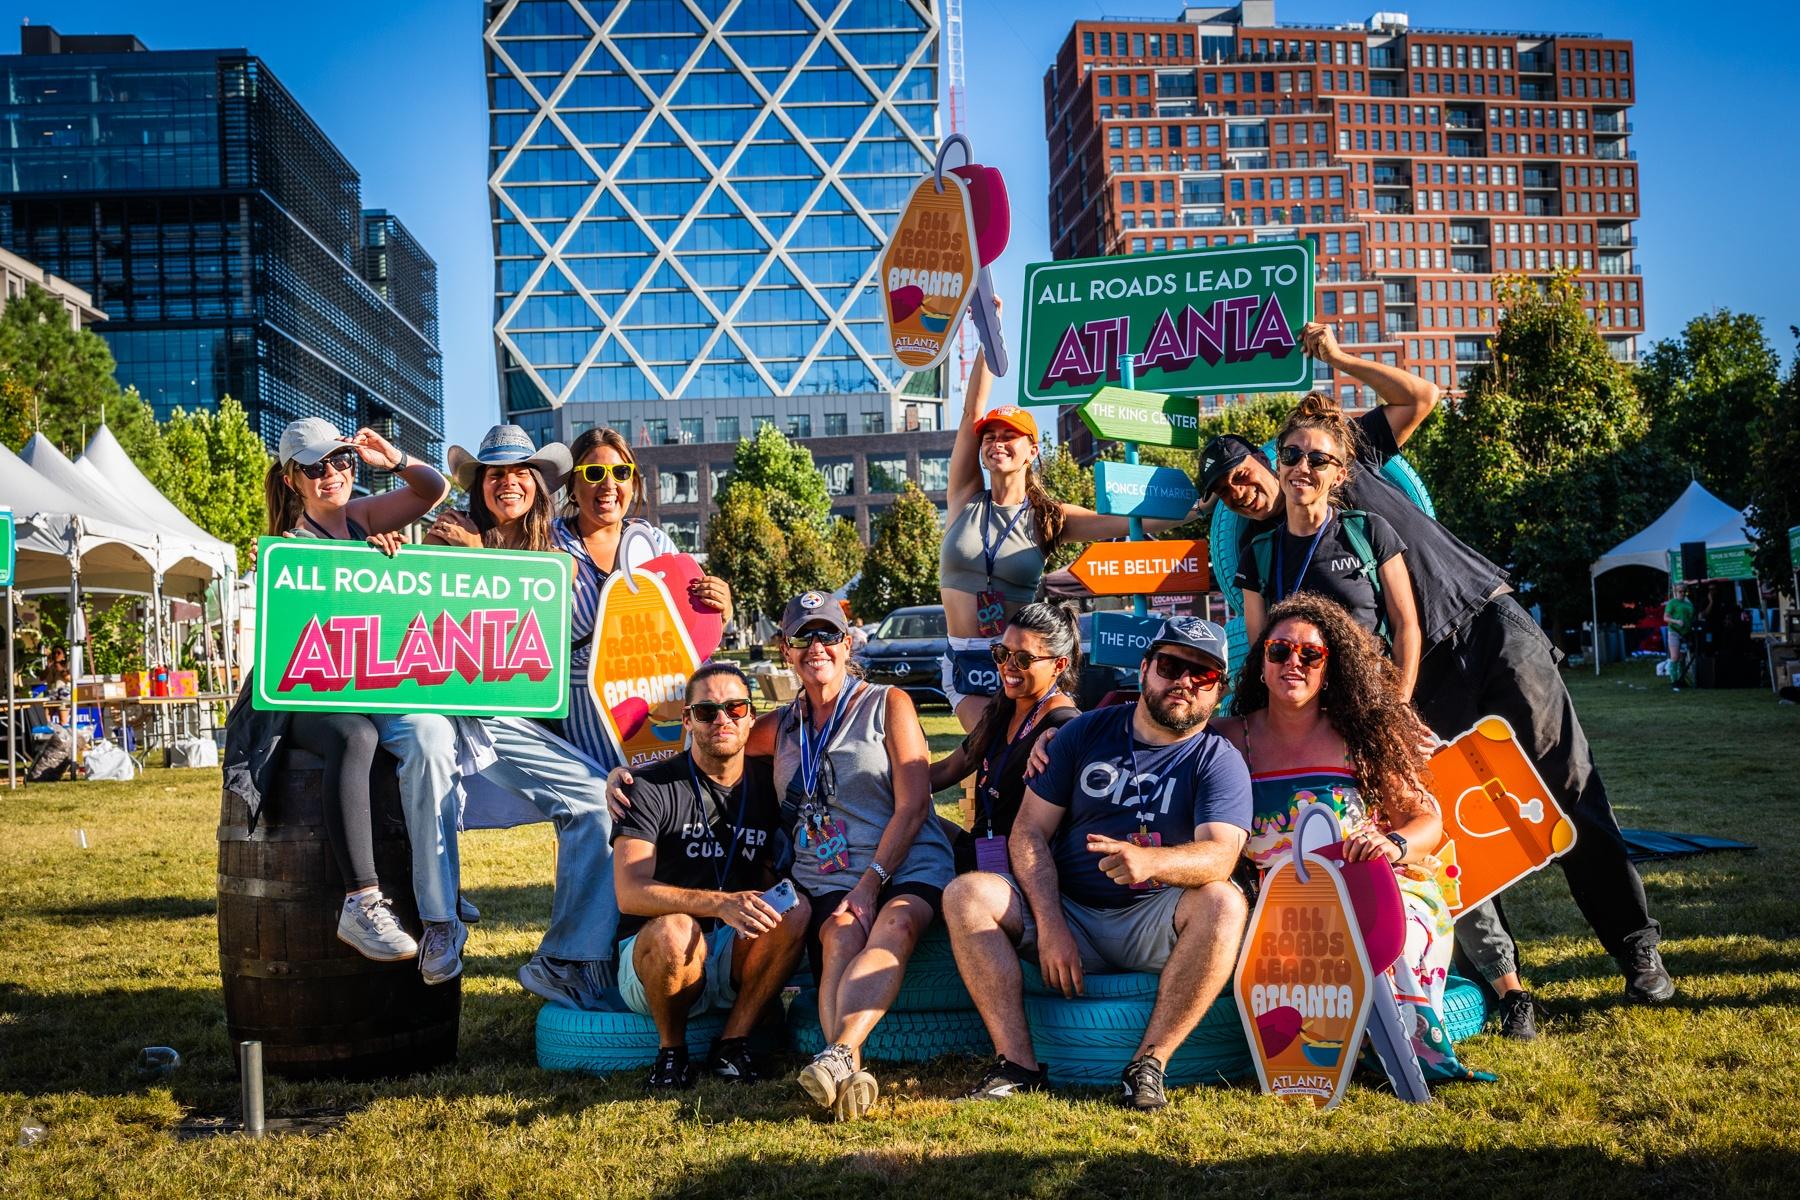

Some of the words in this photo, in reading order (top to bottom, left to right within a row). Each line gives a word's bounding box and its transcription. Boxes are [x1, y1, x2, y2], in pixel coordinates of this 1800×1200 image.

[919, 211, 950, 231] ALL
[900, 228, 963, 251] ROADS
[894, 248, 939, 270] LEAD
[942, 252, 964, 272] TO
[888, 267, 963, 299] ATLANTA
[1038, 282, 1082, 305] ALL
[1089, 273, 1177, 300] ROADS
[1185, 268, 1252, 293] LEAD
[1260, 264, 1297, 287] TO
[894, 336, 940, 351] ATLANTA
[1038, 291, 1296, 389] ATLANTA
[1091, 402, 1115, 418] THE
[1118, 407, 1148, 422] KING
[1151, 411, 1197, 430] CENTER
[1106, 481, 1138, 494] PONCE
[1160, 487, 1197, 500] MARKET
[1086, 560, 1120, 576] THE
[1124, 557, 1199, 575] BELTLINE
[274, 565, 326, 591] ALL
[334, 568, 432, 596] ROADS
[441, 573, 511, 600] LEAD
[519, 577, 556, 602] TO
[621, 613, 655, 635] ALL
[277, 605, 553, 692] ATLANTA
[606, 631, 675, 658] ROADS
[1099, 632, 1124, 646] THE
[1128, 634, 1153, 648] FOX
[604, 656, 655, 680] LEAD
[656, 652, 683, 674] TO
[604, 673, 686, 711] ATLANTA
[681, 822, 767, 846] FOVER
[686, 841, 756, 862] CUBN
[1282, 907, 1324, 932] ALL
[1261, 932, 1345, 957] ROADS
[1254, 958, 1316, 984] LEAD
[1320, 960, 1351, 984] TO
[1251, 984, 1354, 1019] ATLANTA
[1272, 1075, 1334, 1091] ATLANTA
